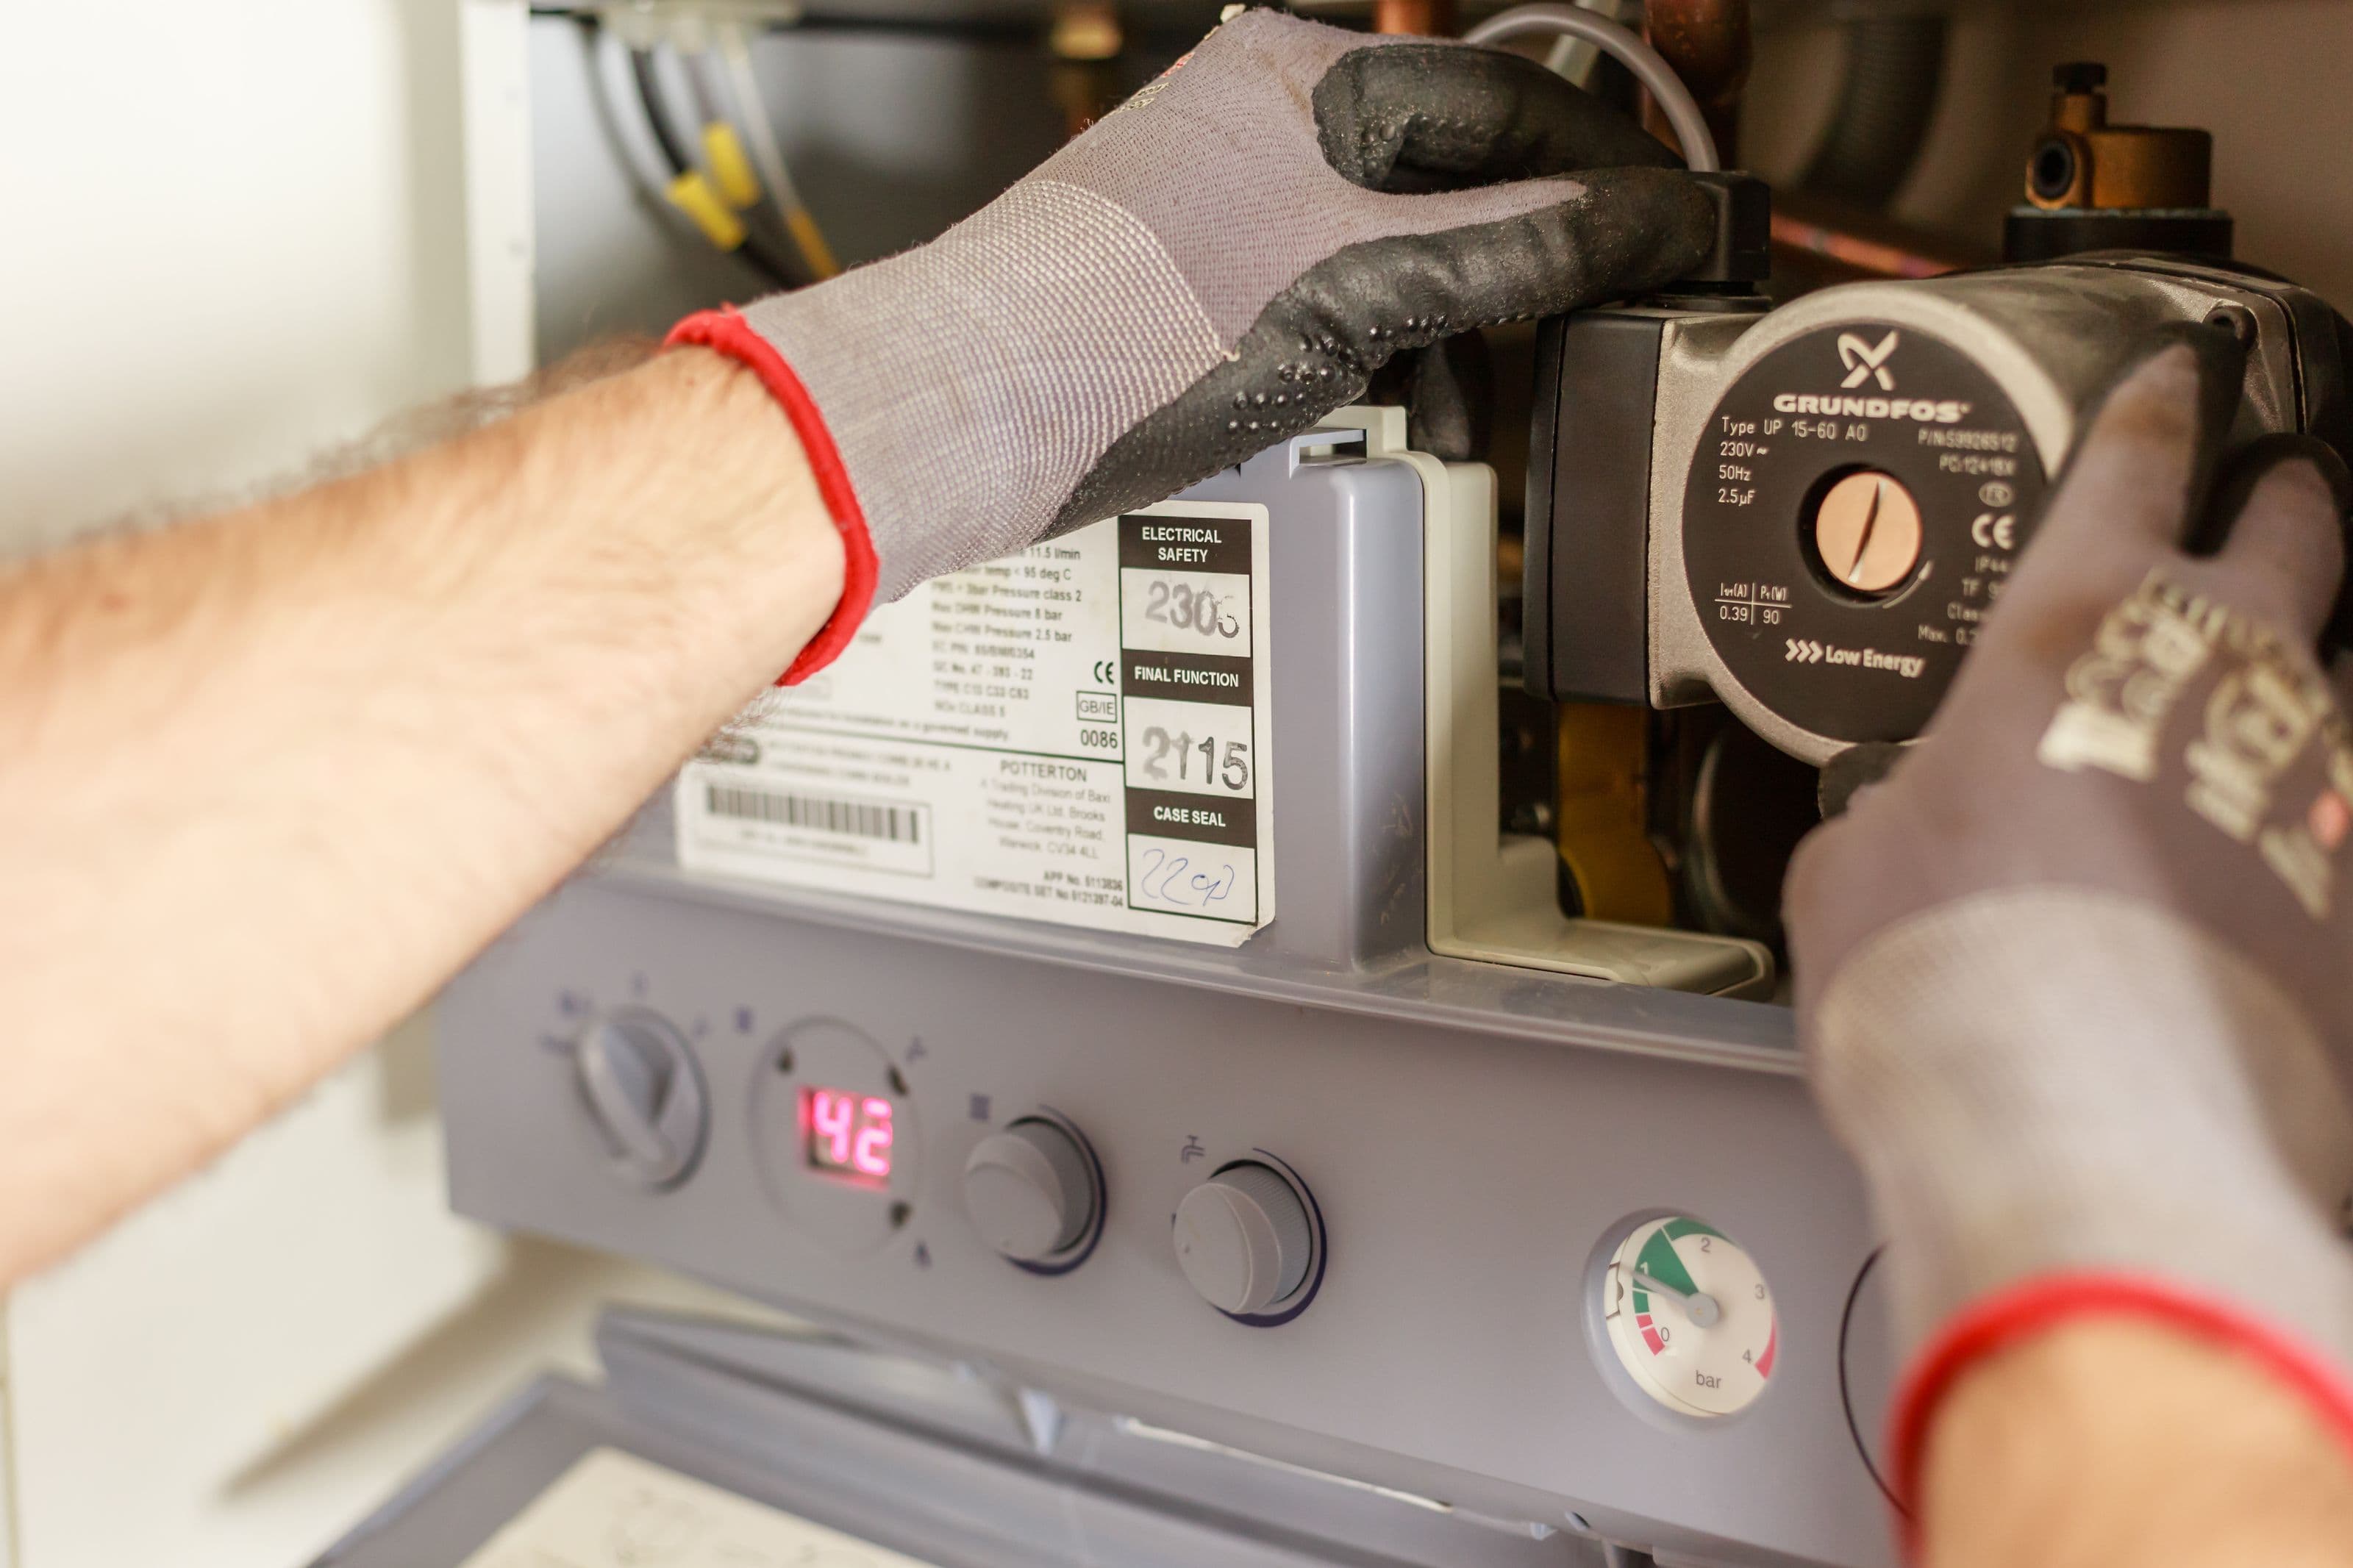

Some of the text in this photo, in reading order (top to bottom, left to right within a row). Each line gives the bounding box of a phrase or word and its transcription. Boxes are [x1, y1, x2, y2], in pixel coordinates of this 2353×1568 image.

[1773, 393, 1962, 423] GRUNDFOS
[1721, 415, 1754, 436] Type
[1764, 418, 1782, 435] UP
[1791, 420, 1837, 440] 15-60
[1719, 465, 1751, 481] 50Hz
[1142, 526, 1222, 543] ELECTRICAL
[1158, 547, 1208, 562] SAFETY
[1024, 568, 1035, 579] 95
[1040, 568, 1059, 582] deg
[1063, 568, 1071, 580] C
[993, 585, 1040, 599] Pressure
[1043, 589, 1071, 601] class
[1076, 590, 1082, 602] 2
[1044, 608, 1063, 620] bar
[1720, 606, 1780, 624] 0.39 90
[1035, 629, 1051, 641] 2.5
[1054, 630, 1072, 642] bar
[1825, 645, 1926, 679] Low Energy
[1135, 665, 1239, 687] FINAL FUNCTION
[1079, 700, 1115, 715] GB/IE
[1081, 729, 1118, 749] 0086
[1001, 760, 1087, 782] POTTERTON
[993, 779, 1029, 797] Trading
[1032, 783, 1072, 798] Division
[1075, 789, 1085, 800] of
[1088, 790, 1110, 803] Baxi
[1069, 806, 1105, 822] Brooks
[1154, 806, 1226, 827] CASE SEAL
[1026, 821, 1071, 838] Coventry
[813, 1091, 893, 1175] 42
[1701, 1236, 1711, 1253] 2
[1754, 1284, 1765, 1300] 3
[1660, 1327, 1670, 1342] 0
[1742, 1349, 1752, 1364] 4
[1696, 1370, 1721, 1389] bar
